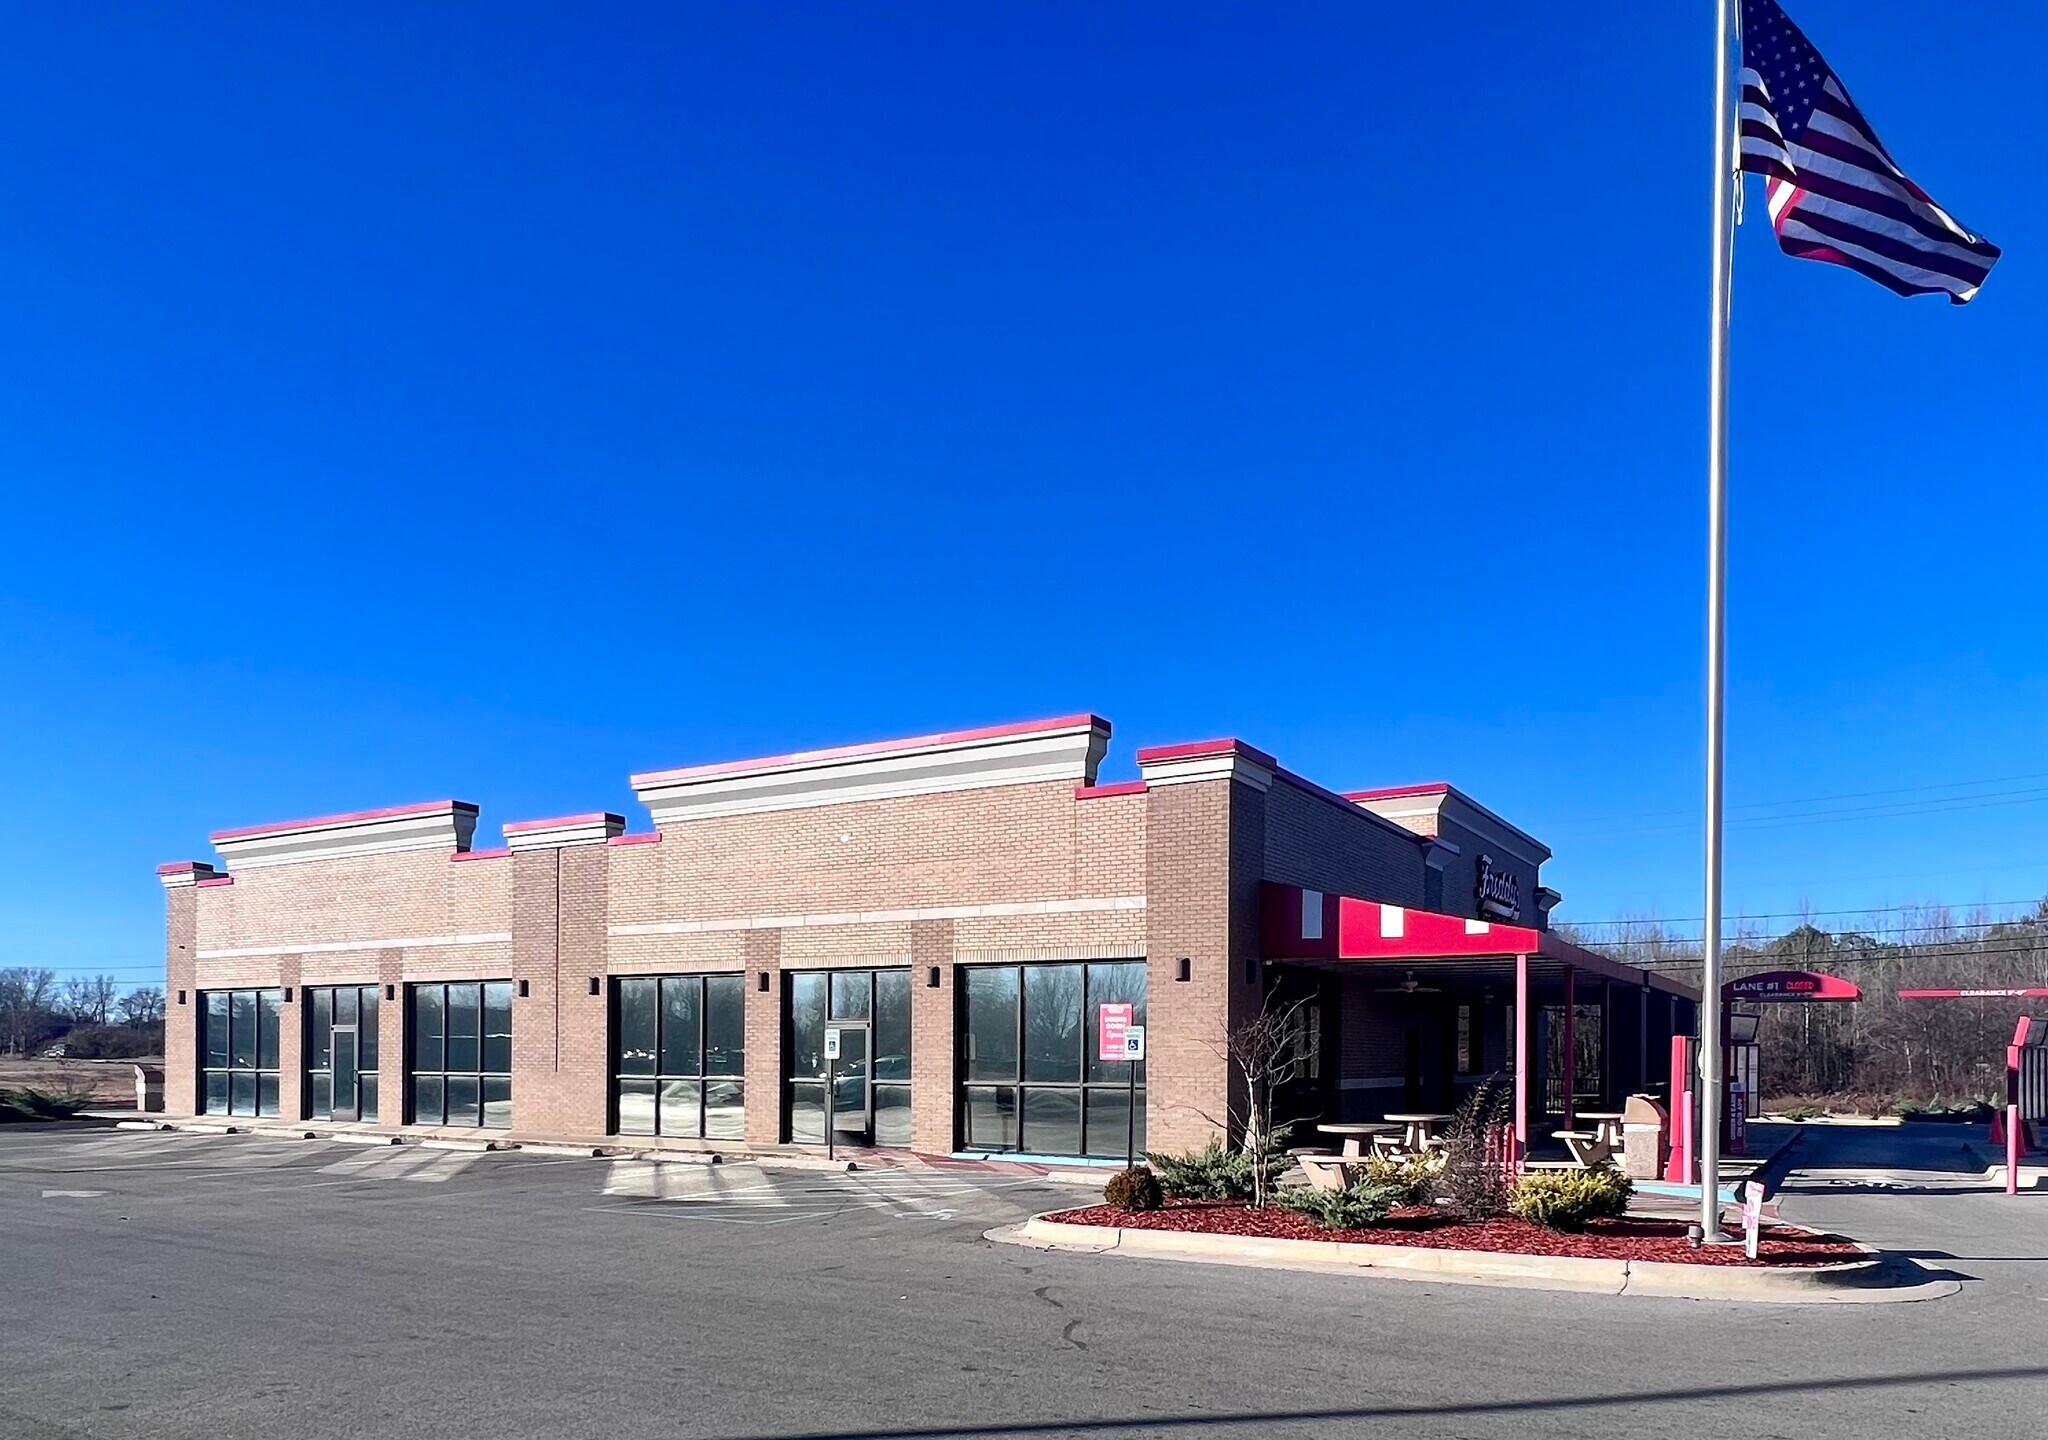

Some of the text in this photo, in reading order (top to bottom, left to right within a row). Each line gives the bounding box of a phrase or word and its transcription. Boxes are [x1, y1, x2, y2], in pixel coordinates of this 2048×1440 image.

[1733, 981, 1815, 991] LANE #1 CLOSED
[1960, 989, 2006, 997] CLEARANCE
